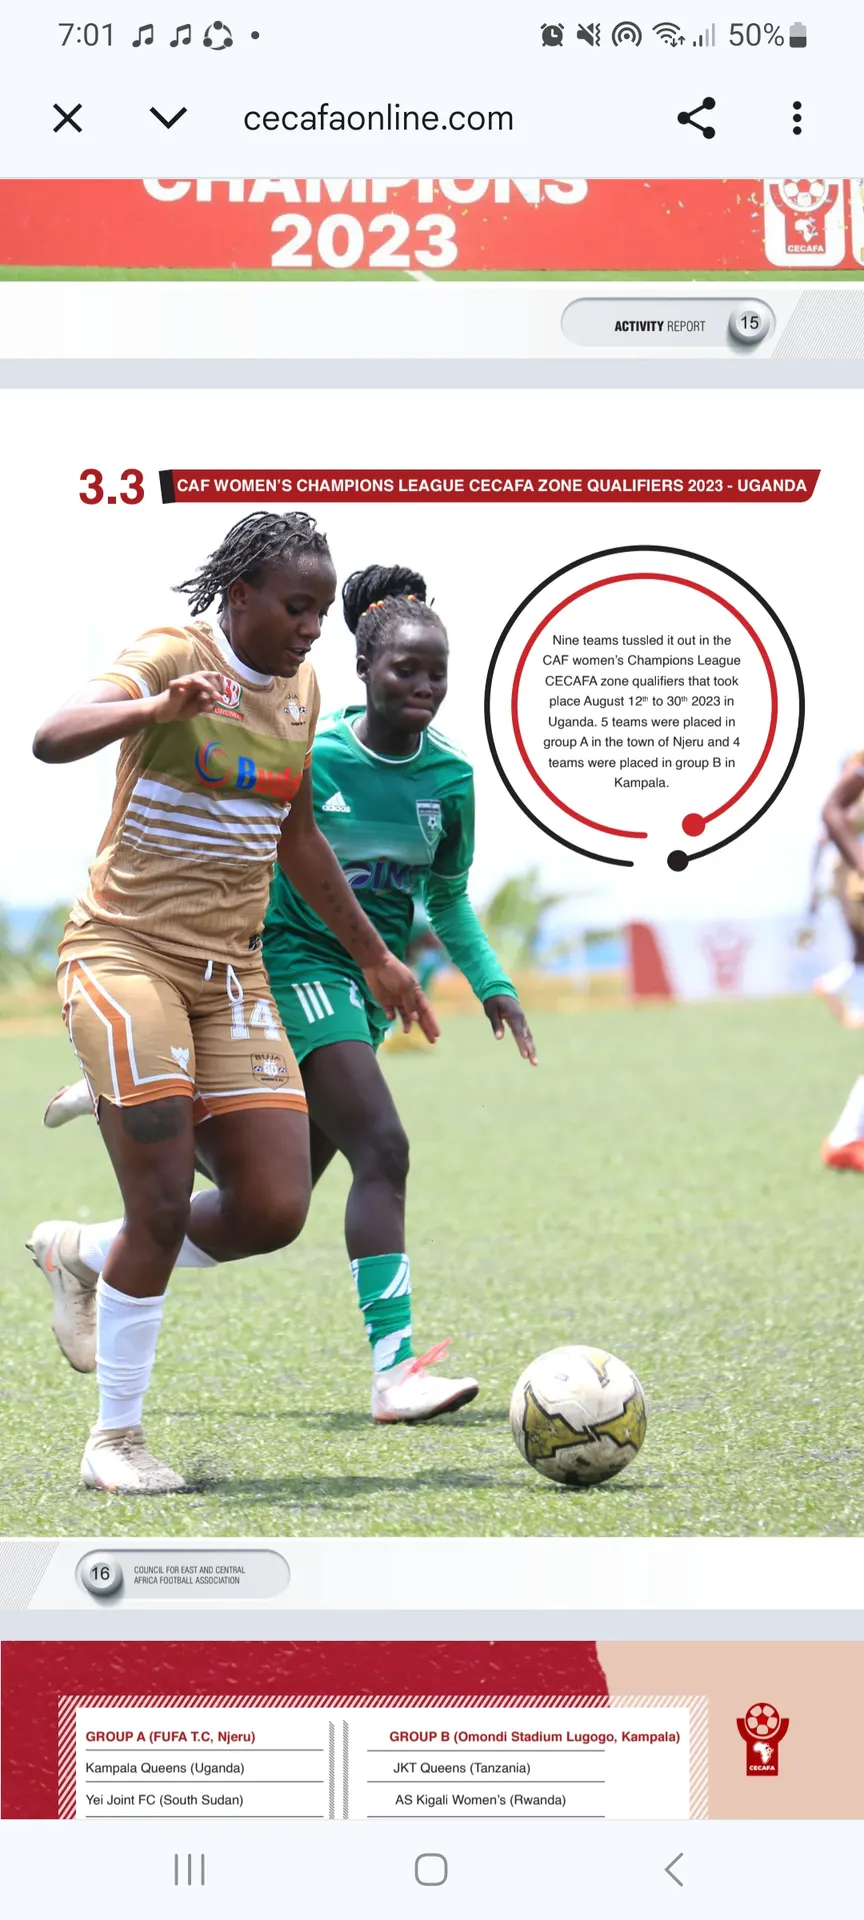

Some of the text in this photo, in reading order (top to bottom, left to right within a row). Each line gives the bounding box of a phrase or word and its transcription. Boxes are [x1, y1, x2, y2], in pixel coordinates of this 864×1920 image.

[58, 22, 112, 47] 7:01
[729, 22, 785, 47] 50%
[243, 102, 513, 131] cecafaonline.com
[270, 213, 458, 268] 2023
[787, 244, 825, 253] CECAFA
[614, 320, 706, 332] ACTIVITY REPORT
[740, 315, 759, 330] 15
[78, 467, 145, 506] 3.3
[176, 478, 211, 493] CAF
[296, 478, 395, 493] CHAMPIONS
[398, 478, 465, 493] LEAGUE
[468, 478, 535, 493] CECAFA
[537, 478, 583, 493] ZONE
[586, 478, 684, 493] QUALIFIERS
[687, 478, 724, 493] 2023
[737, 478, 808, 493] UGANDA
[552, 634, 732, 646] Nine teams tussled it out in the
[542, 654, 569, 666] CAF
[627, 654, 695, 669] Champions
[697, 654, 742, 669] League
[544, 675, 739, 689] CECAFA zone qualifiers that took
[549, 695, 581, 709] place
[583, 695, 625, 709] August
[651, 696, 664, 707] to
[691, 695, 721, 707] 2023
[723, 695, 735, 707] in
[548, 715, 736, 730] Uganda. 5 teams were placed in
[543, 735, 741, 750] group A in the town of Njeru and 4
[548, 756, 736, 771] teams were placed in group B in
[614, 776, 670, 791] Kampala.
[229, 998, 281, 1042] 14
[91, 1566, 110, 1581] 16
[134, 1565, 246, 1575] COUNCIL FOR EAST AND CENTRAL
[133, 1575, 240, 1585] AFRICA FOOTBALL ASSOCIATION
[85, 1730, 256, 1745] GROUP A (FUFA T.C, Njeru)
[389, 1730, 681, 1745] GROUP B (Omondi Stadium Lugogo, Kampala)
[85, 1762, 245, 1777] Kampala Queens (Uganda)
[392, 1761, 531, 1776] JKT Queens (Tanzania)
[748, 1764, 776, 1772] CECAFA
[85, 1793, 244, 1808] Yei Joint FC (South Sudan)
[394, 1793, 413, 1806] AS
[416, 1793, 448, 1809] Kigali
[509, 1793, 567, 1808] (Rwanda)
